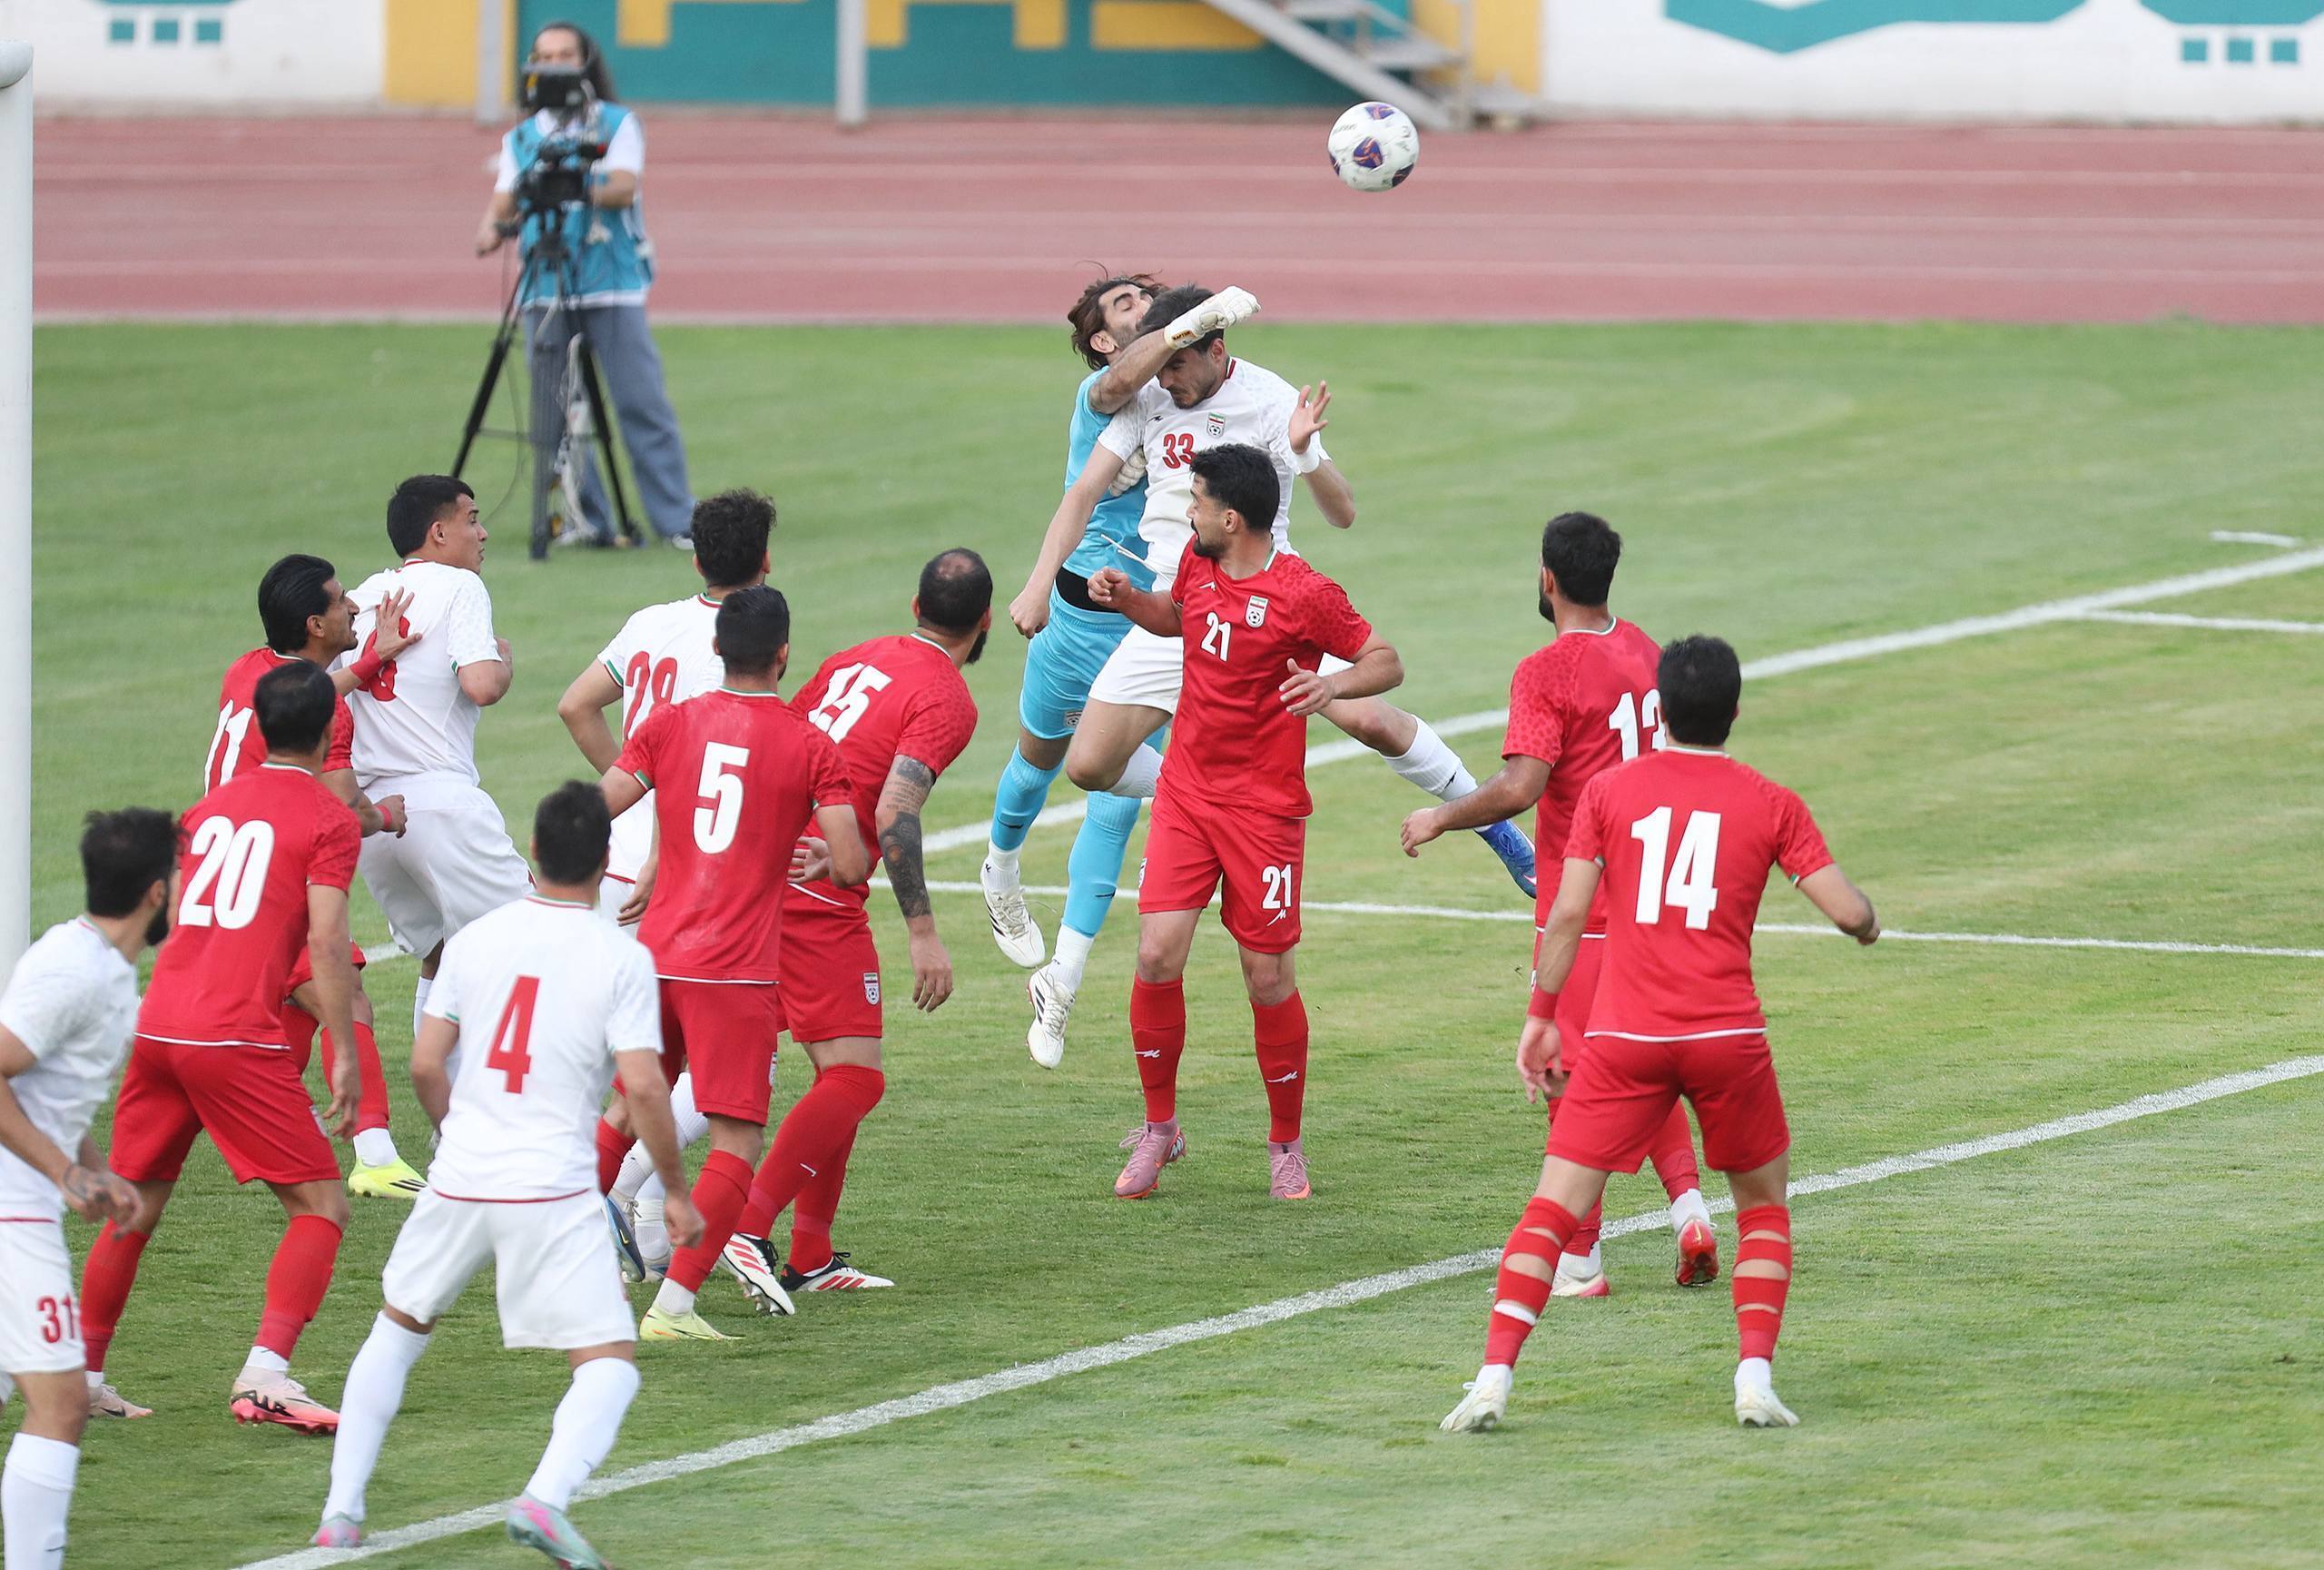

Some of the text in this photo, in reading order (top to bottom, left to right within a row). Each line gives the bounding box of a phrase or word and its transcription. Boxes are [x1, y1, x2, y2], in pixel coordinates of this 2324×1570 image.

[1163, 433, 1197, 469] 33
[1200, 611, 1232, 662] 21
[807, 662, 893, 745] 15
[693, 740, 751, 854] 5
[178, 815, 275, 929] 20
[1262, 864, 1292, 909] 21
[1630, 805, 1722, 931] 14
[486, 975, 541, 1095] 4
[37, 1292, 75, 1344] 31
